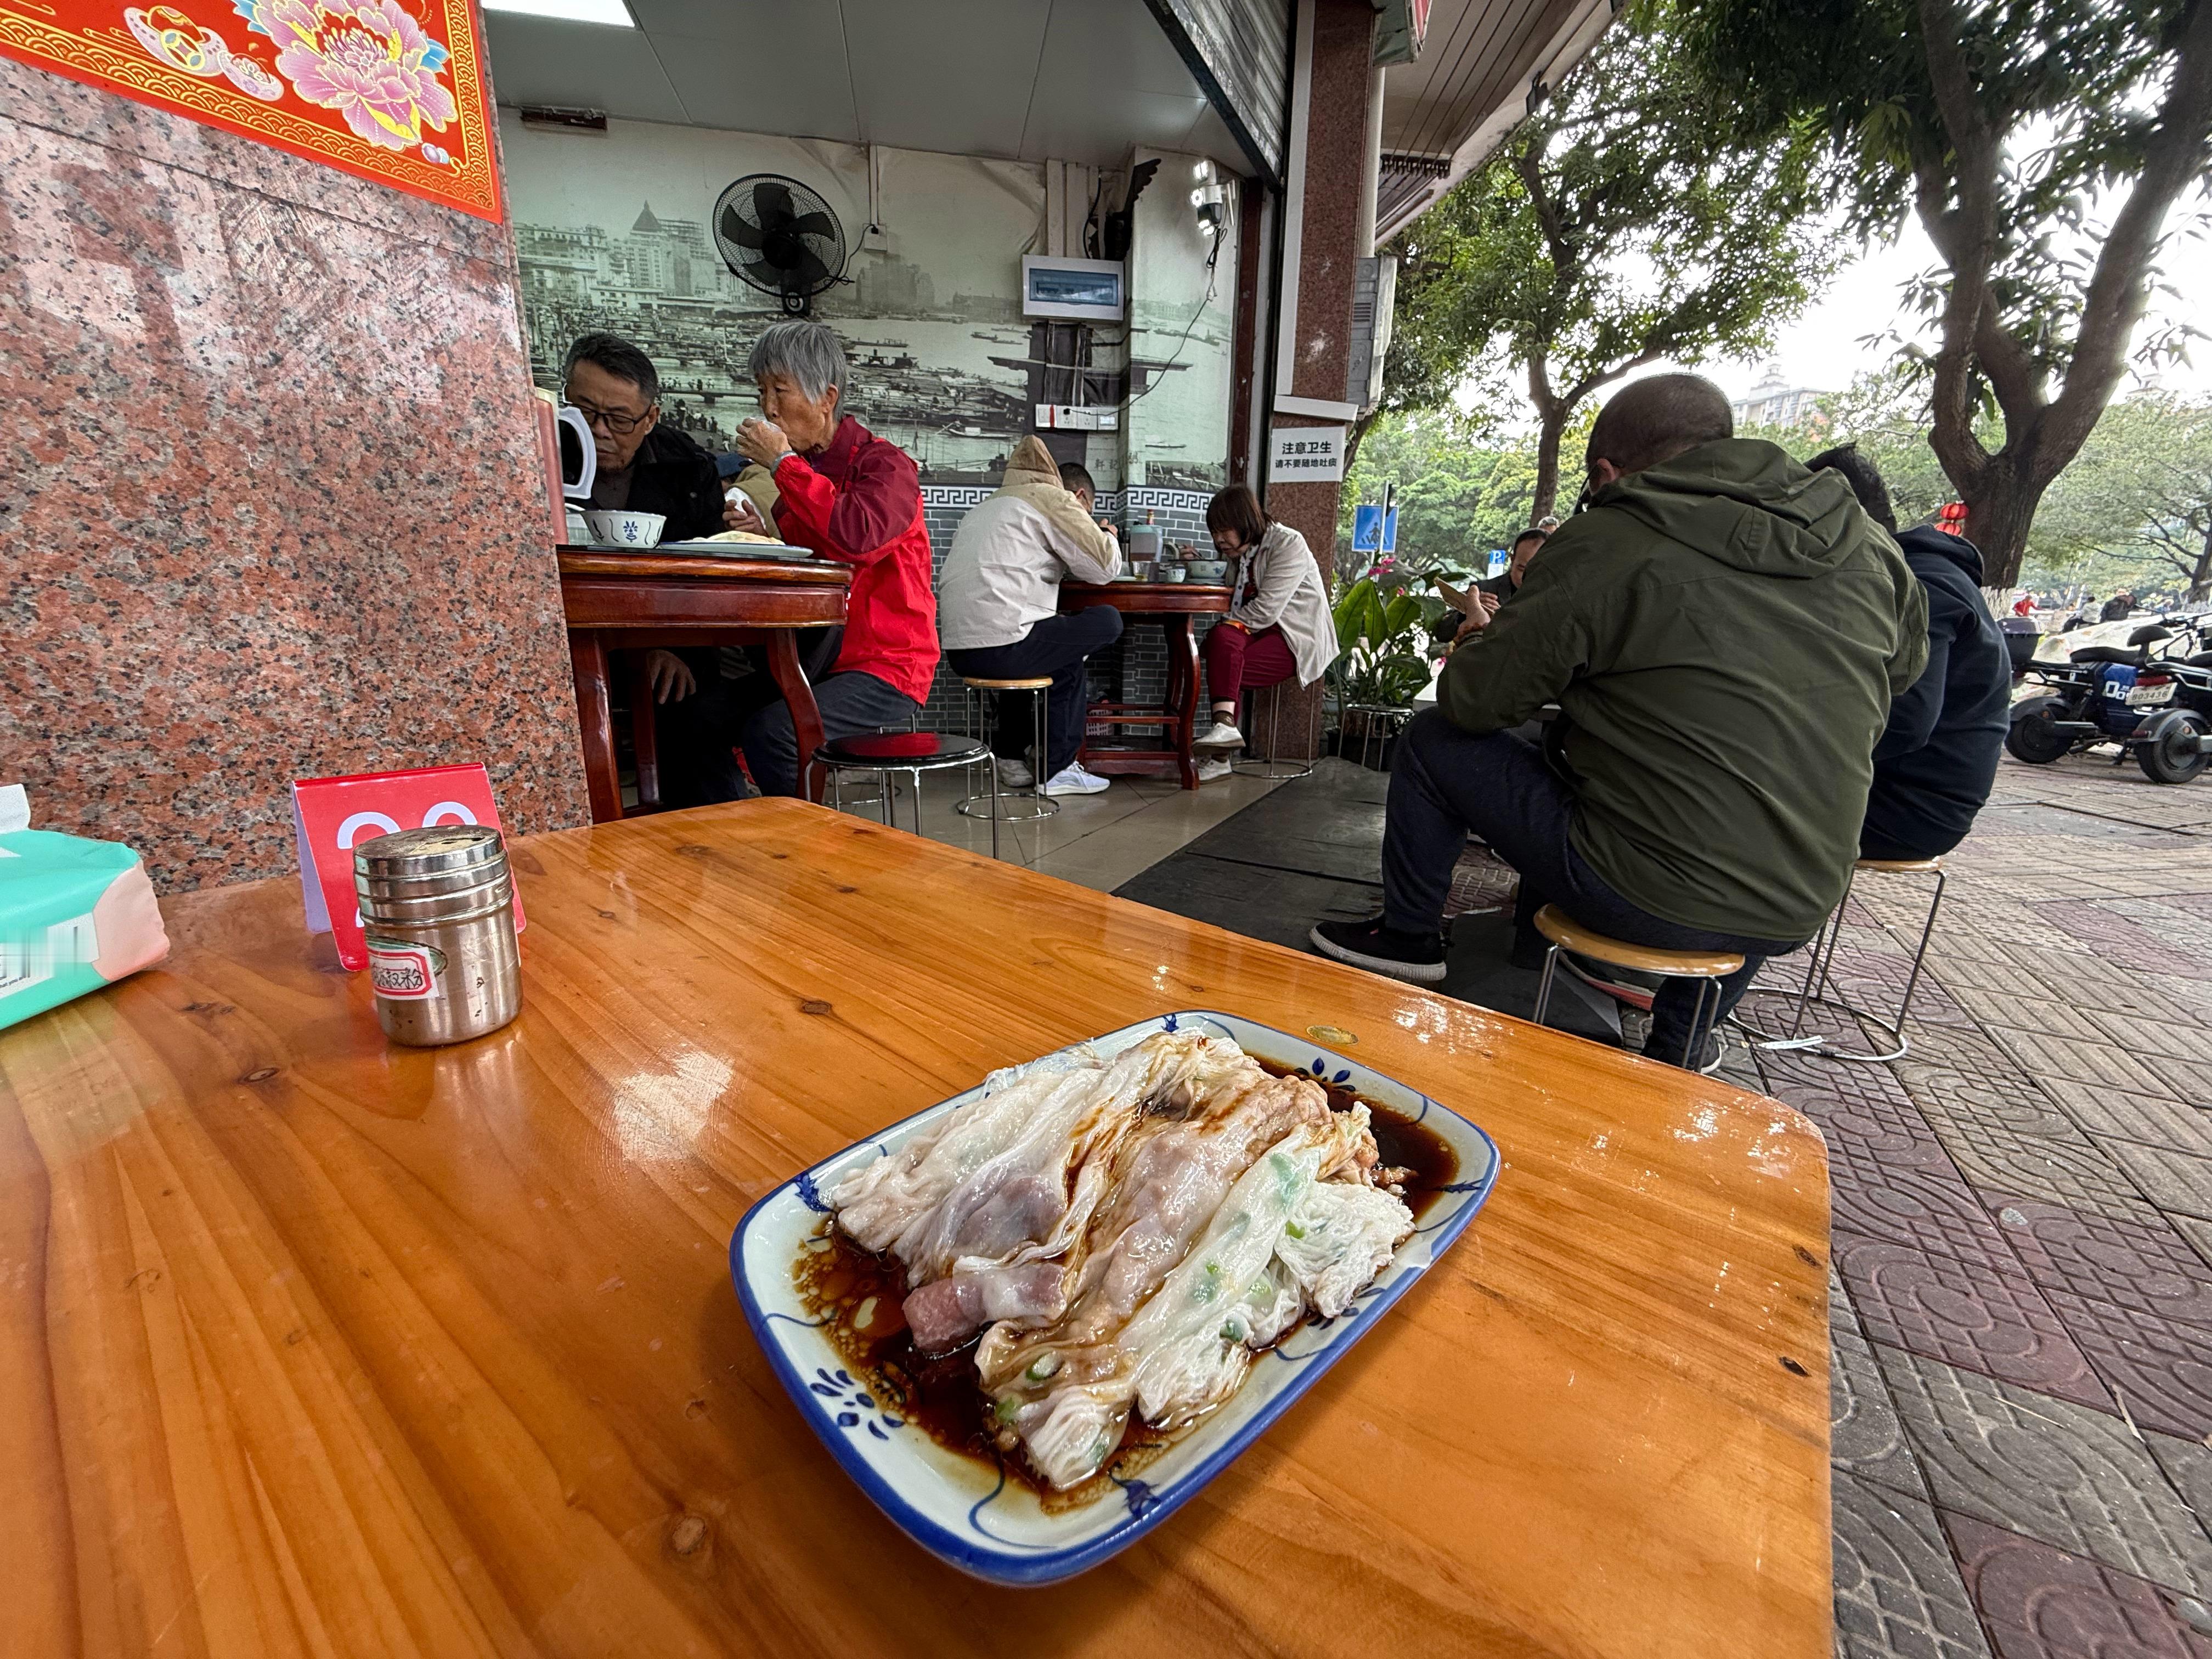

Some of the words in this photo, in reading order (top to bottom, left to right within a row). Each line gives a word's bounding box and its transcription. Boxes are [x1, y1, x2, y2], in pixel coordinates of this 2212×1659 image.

[1282, 441, 1331, 454] 注意卫生
[1276, 458, 1337, 468] 请不要随地吐痰
[1493, 550, 1502, 564] P
